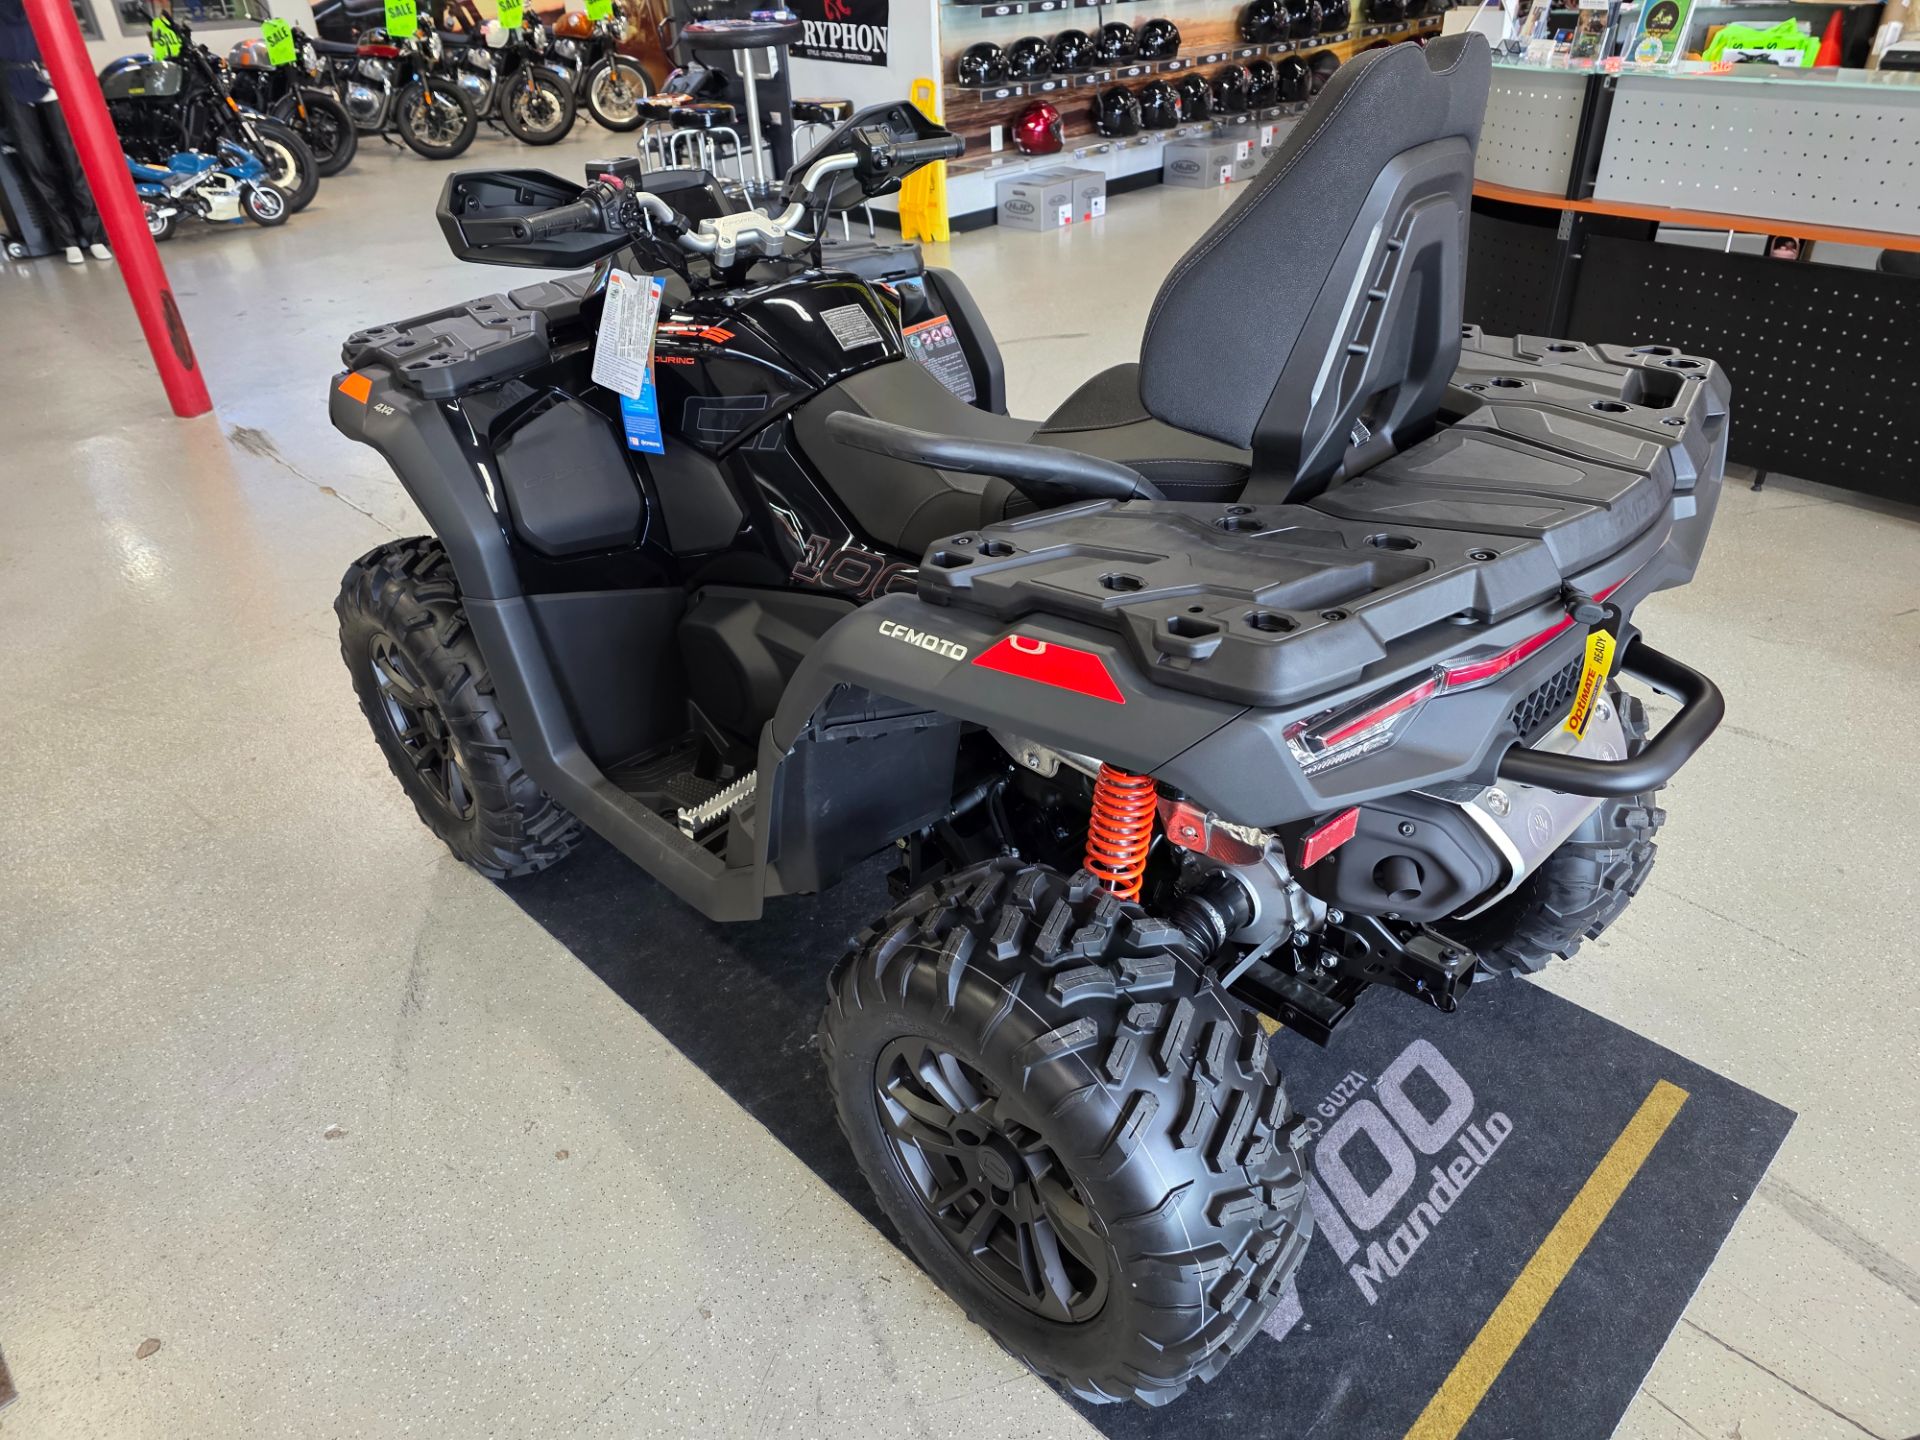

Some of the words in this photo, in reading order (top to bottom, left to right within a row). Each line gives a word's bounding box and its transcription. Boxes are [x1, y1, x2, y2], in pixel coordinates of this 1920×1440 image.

[388, 3, 413, 18] SALE
[266, 26, 289, 47] SALE
[795, 20, 888, 53] RYPHON
[878, 620, 968, 661] CFMOTO
[1569, 669, 1596, 730] OptiMATE
[1593, 636, 1607, 664] READY
[1317, 1070, 1368, 1118] GUZZI
[1349, 1111, 1514, 1306] Mandello
